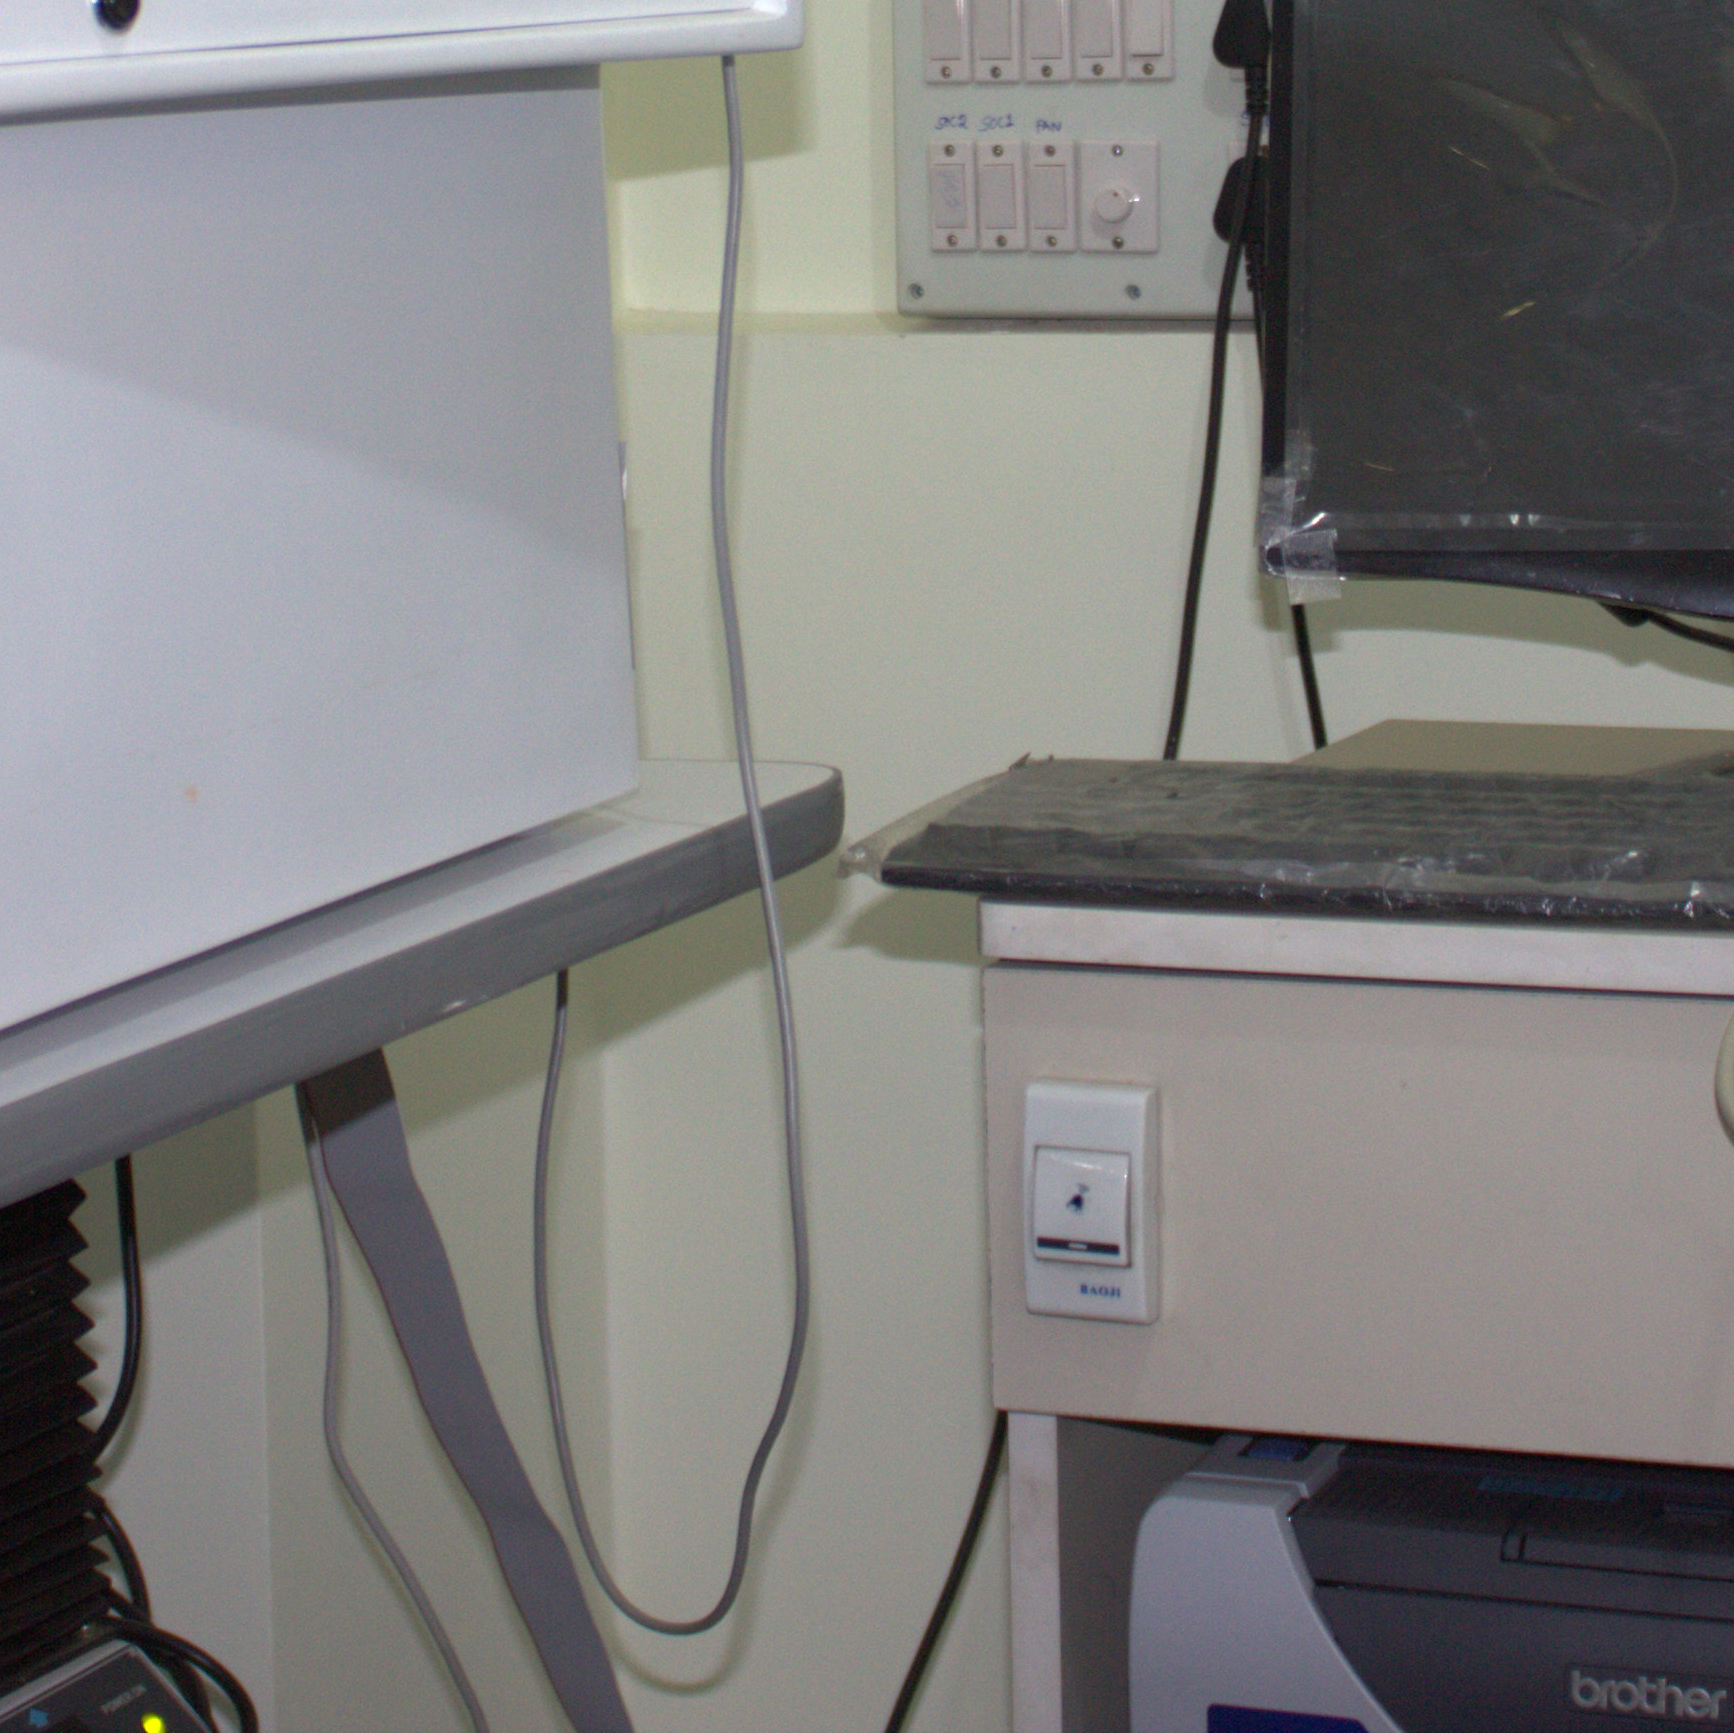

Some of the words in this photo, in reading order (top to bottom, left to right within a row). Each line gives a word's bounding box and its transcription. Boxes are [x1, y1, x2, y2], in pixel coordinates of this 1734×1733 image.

[1035, 119, 1063, 133] FAN
[1079, 1284, 1122, 1299] BAOJI
[1570, 1669, 1728, 1719] brother
